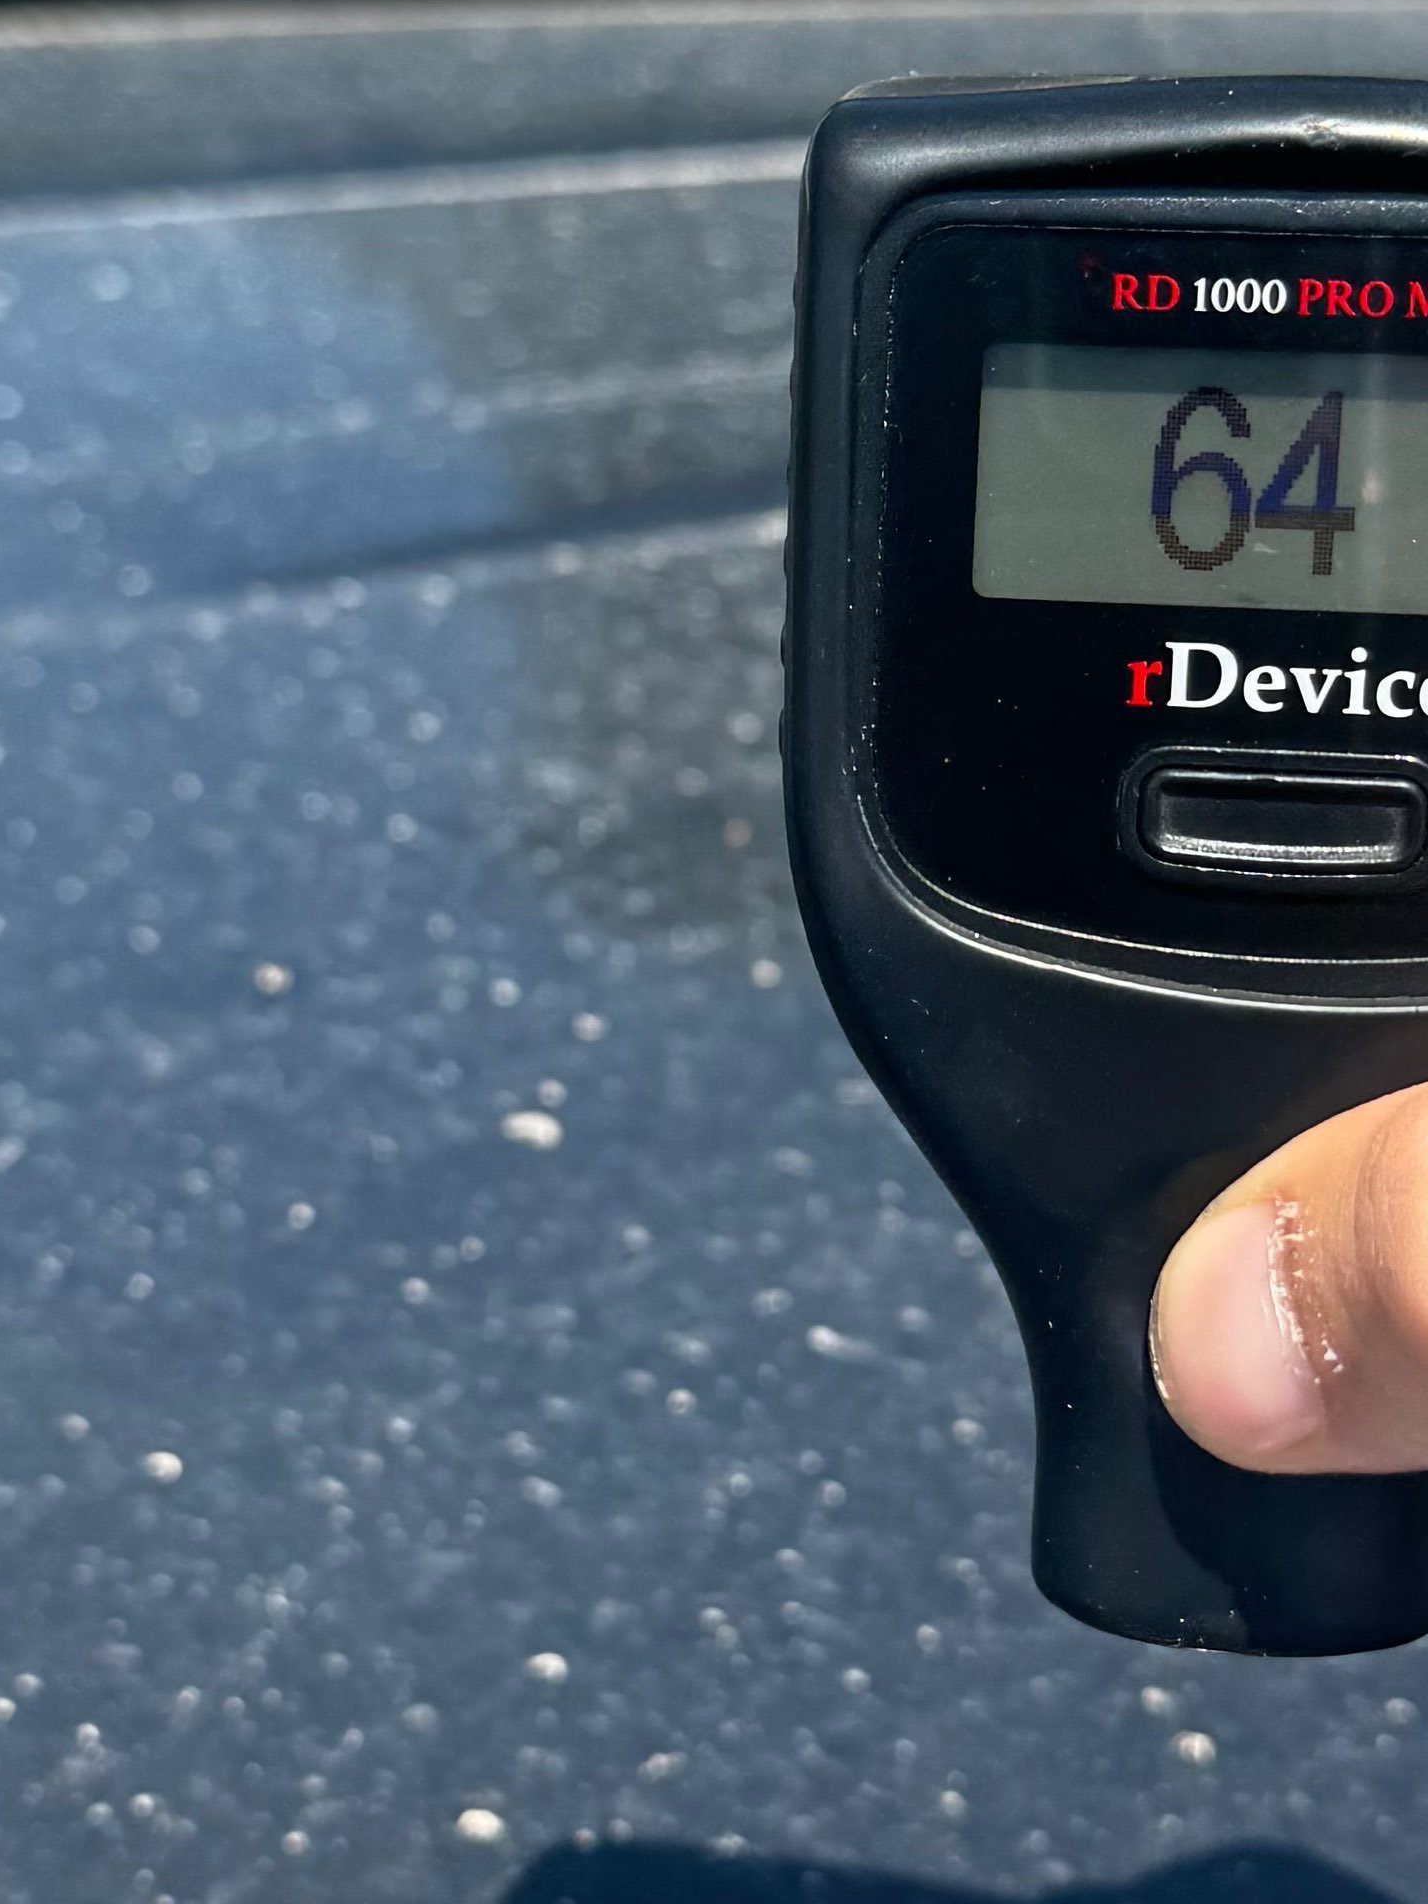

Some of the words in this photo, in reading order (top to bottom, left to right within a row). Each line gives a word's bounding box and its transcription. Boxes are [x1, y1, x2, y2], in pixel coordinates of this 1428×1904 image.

[1112, 272, 1180, 312] RD
[1193, 276, 1288, 315] 1000
[1297, 278, 1395, 320] PRO
[1150, 385, 1356, 576] 64
